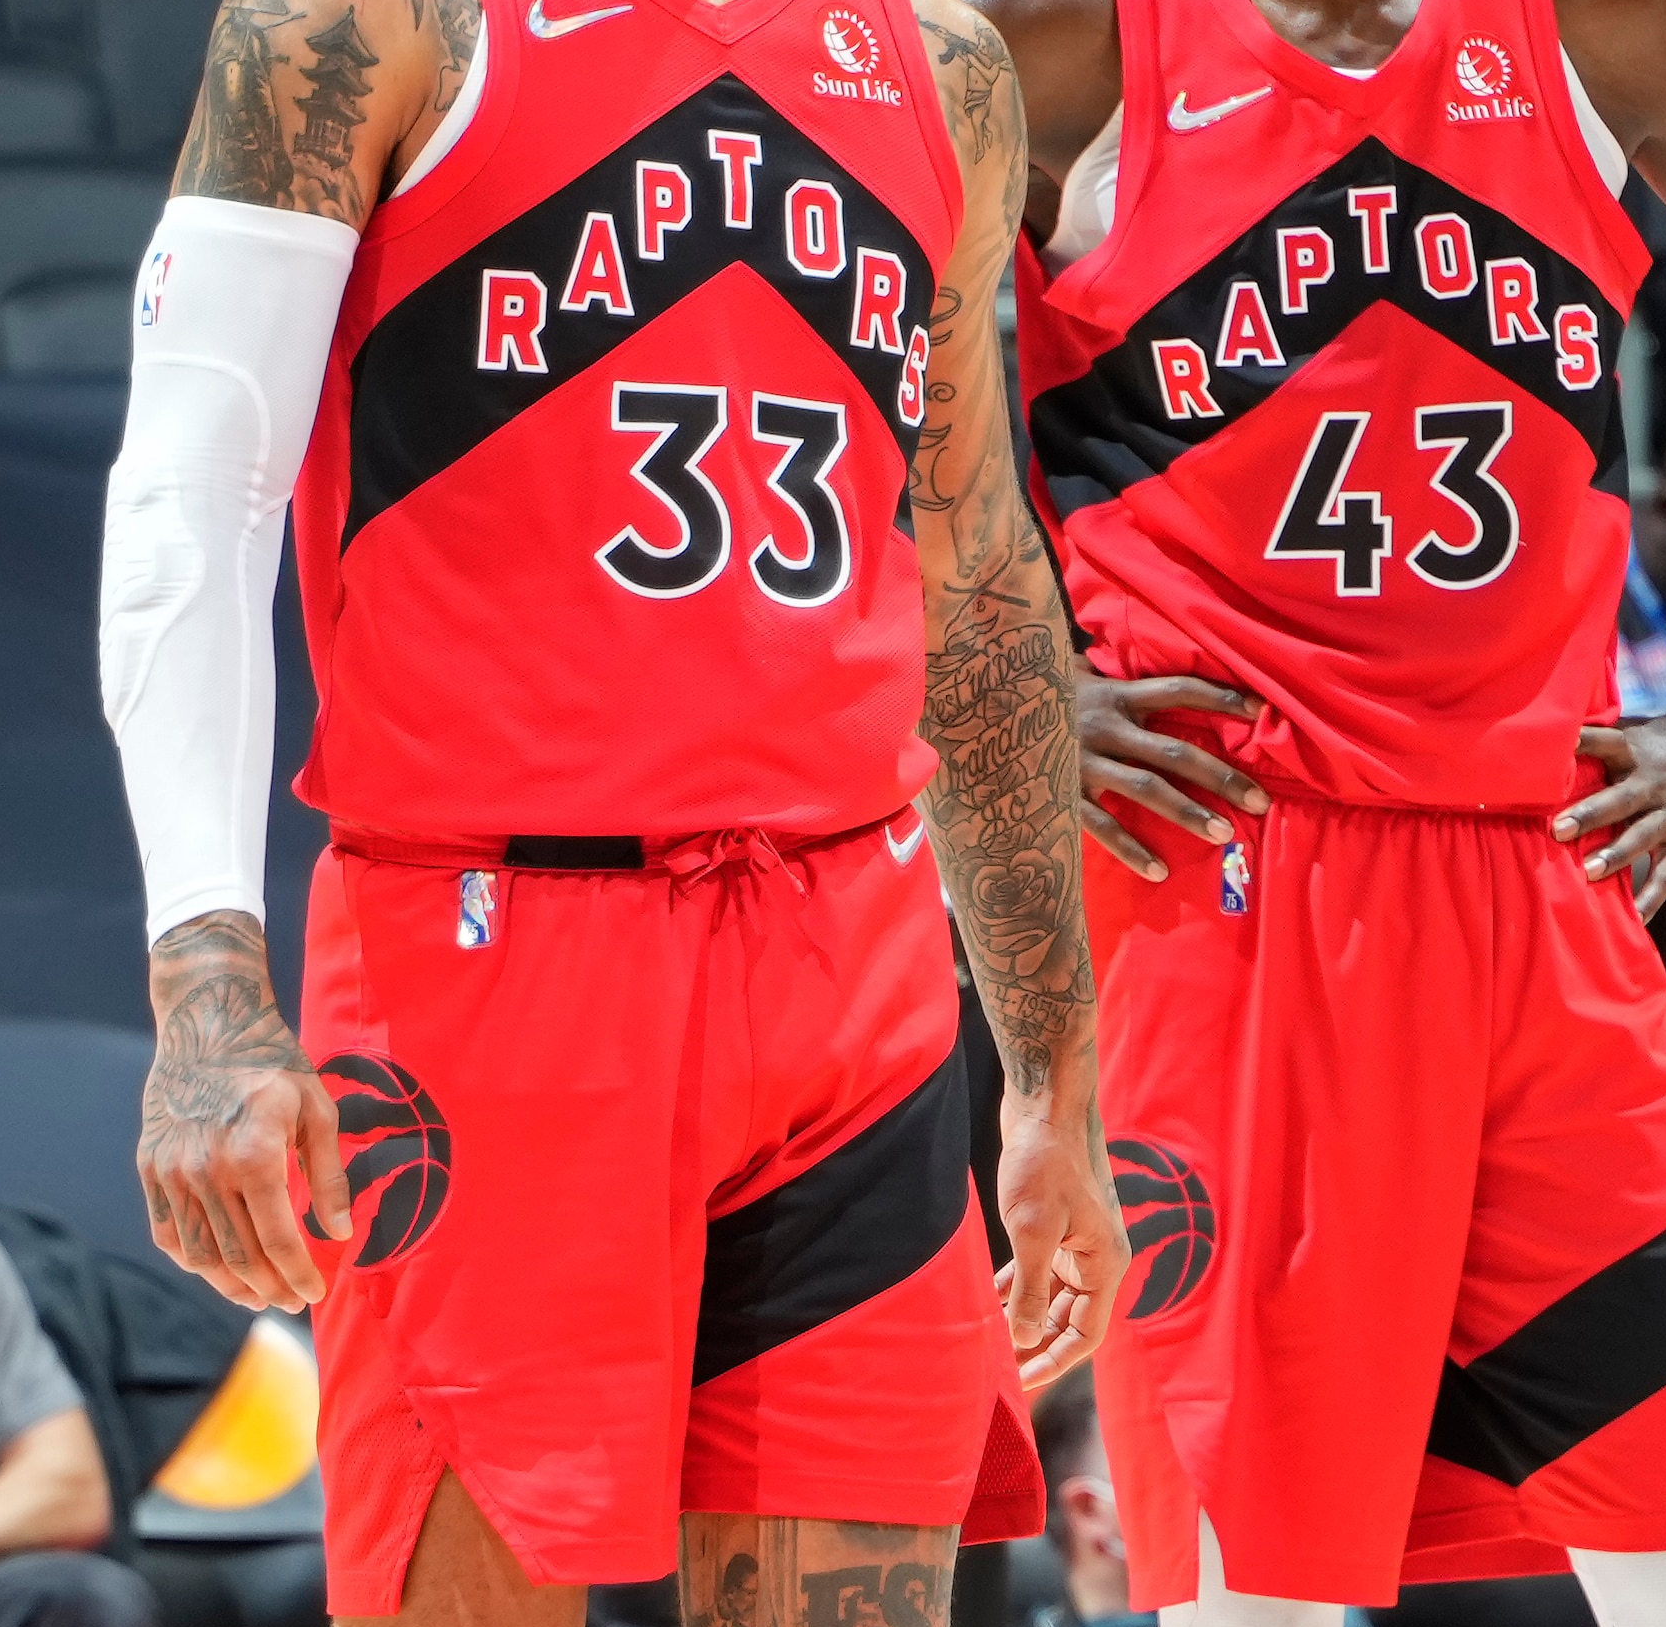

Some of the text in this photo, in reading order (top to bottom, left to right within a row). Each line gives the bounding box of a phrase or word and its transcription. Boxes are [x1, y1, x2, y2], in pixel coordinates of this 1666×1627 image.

[812, 71, 902, 106] Sun Life
[1446, 96, 1534, 122] Sun Life
[477, 129, 929, 428] RAPTORS
[1152, 186, 1602, 421] RAPTORS
[594, 381, 851, 608] 33
[1264, 401, 1519, 597] 43
